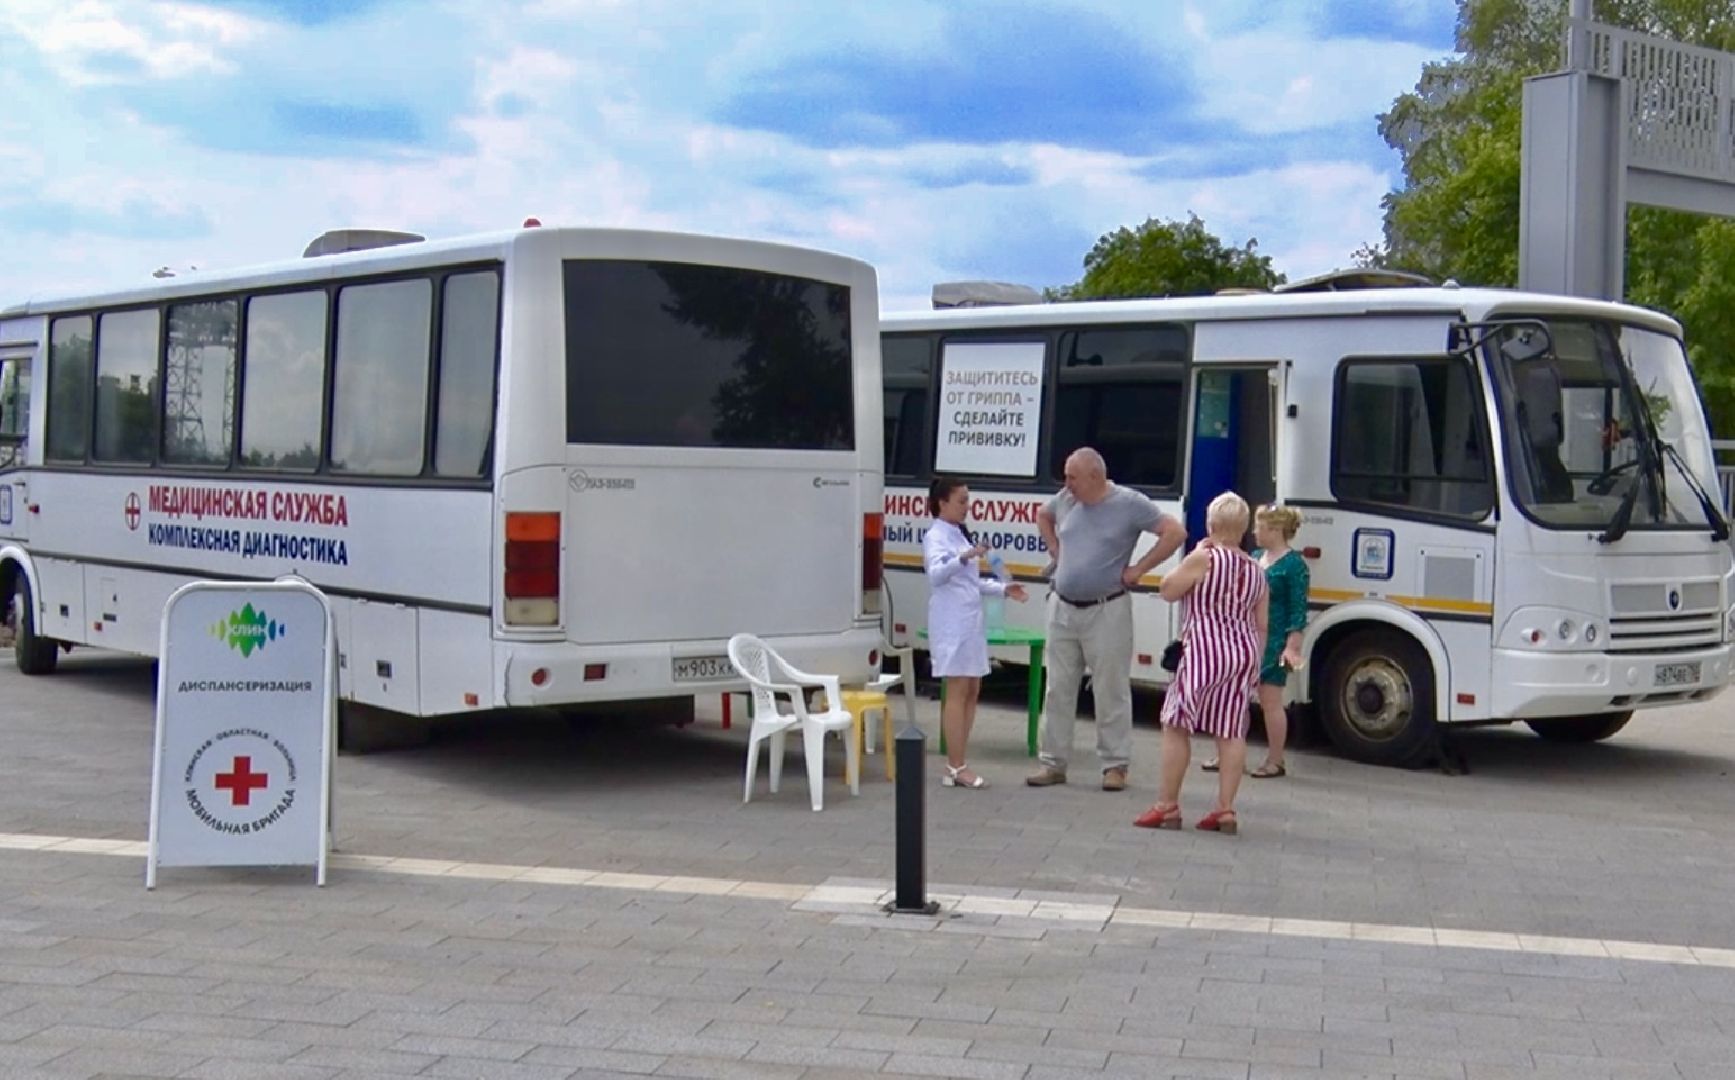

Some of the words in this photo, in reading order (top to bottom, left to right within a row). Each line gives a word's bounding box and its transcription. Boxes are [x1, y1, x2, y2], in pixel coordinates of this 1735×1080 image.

[947, 370, 1038, 387] ЗАЩИТИТЕСЬ
[947, 391, 964, 405] ОТ
[968, 391, 1022, 406] ГРИППА
[954, 408, 1024, 428] СДЕЛАЙТЕ
[948, 430, 1026, 448] ПРИВИВКУ!
[149, 485, 268, 521] МЕДИЦИНСКАЯ
[272, 491, 348, 528] СЛУЖБА
[884, 494, 929, 517] ИНС
[149, 522, 241, 554] КОМПЛЕКСНАЯ
[242, 530, 348, 566] ДИАГНОСТИКА
[178, 680, 312, 693] ДИСПАНСЕРИЗАЦИЯ
[185, 789, 250, 834] МОБИЛЬНАЯ
[251, 789, 296, 832] БРИГАДА
